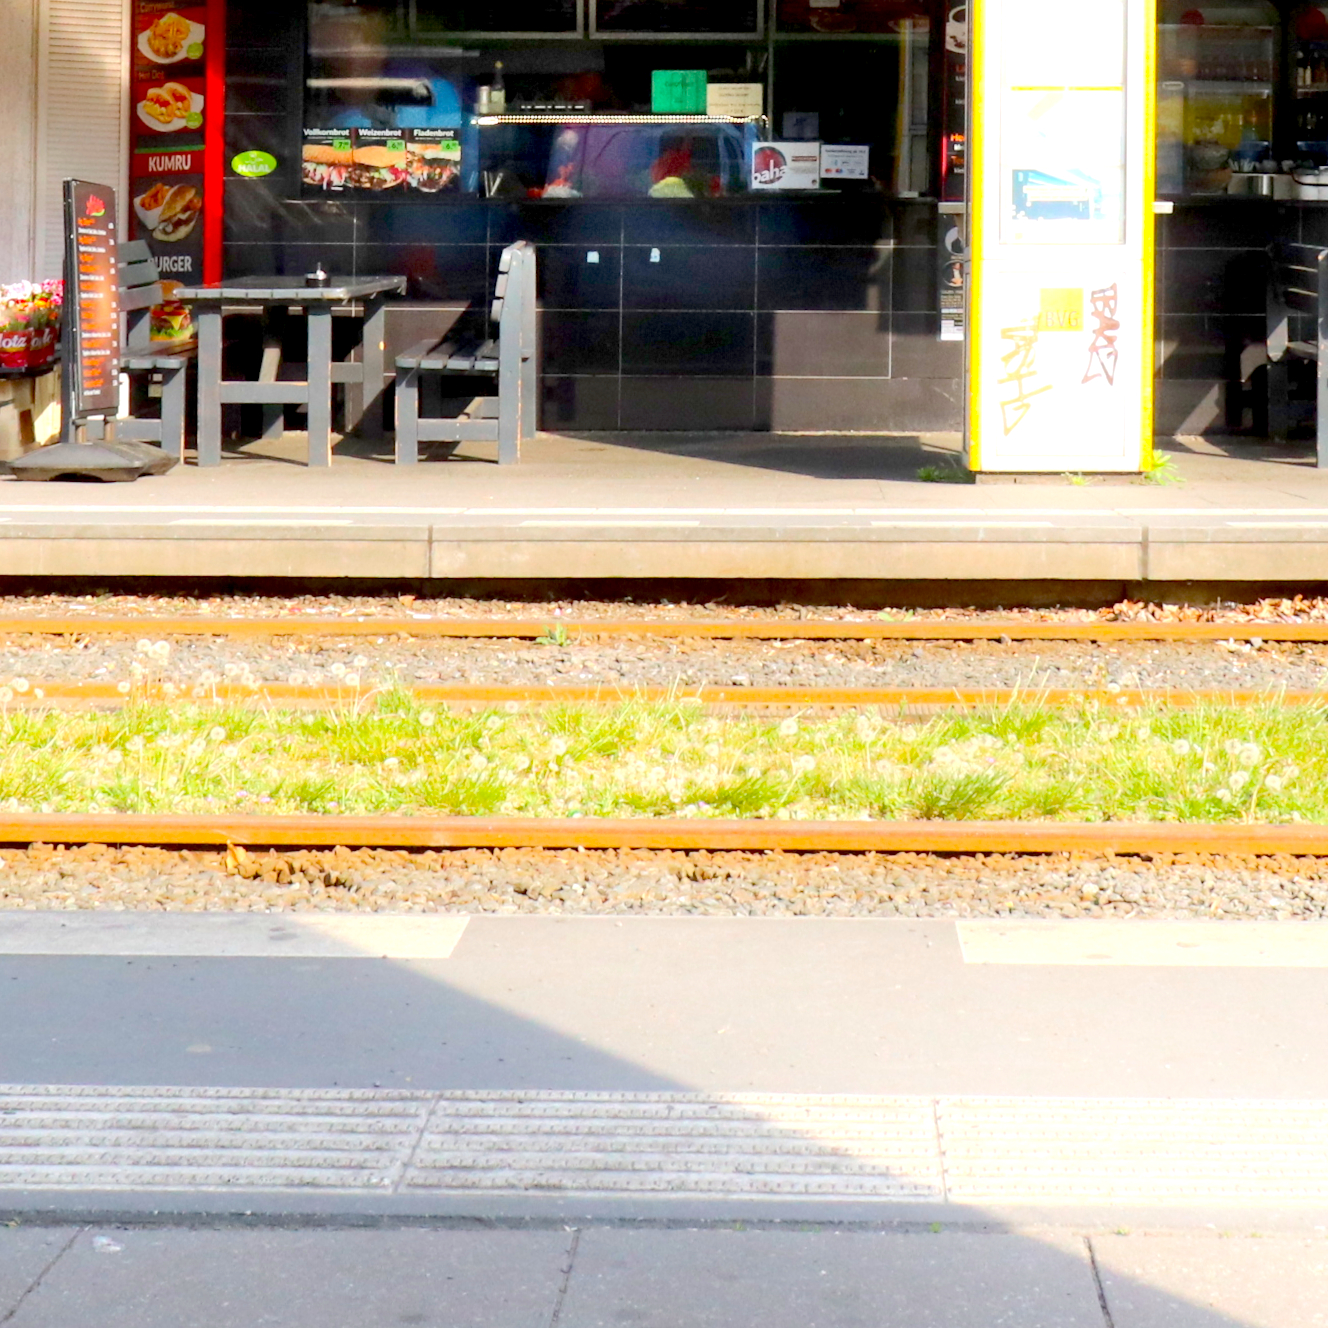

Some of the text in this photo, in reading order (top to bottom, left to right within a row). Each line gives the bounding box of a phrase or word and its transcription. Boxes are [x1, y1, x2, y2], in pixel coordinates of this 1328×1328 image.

[302, 128, 350, 137] Vollkornbrot
[357, 128, 402, 137] Weizenbrot
[413, 128, 455, 137] Fladenbrot
[148, 152, 192, 172] KUMRU
[237, 163, 270, 173] HALAL
[1045, 310, 1079, 328] BVG
